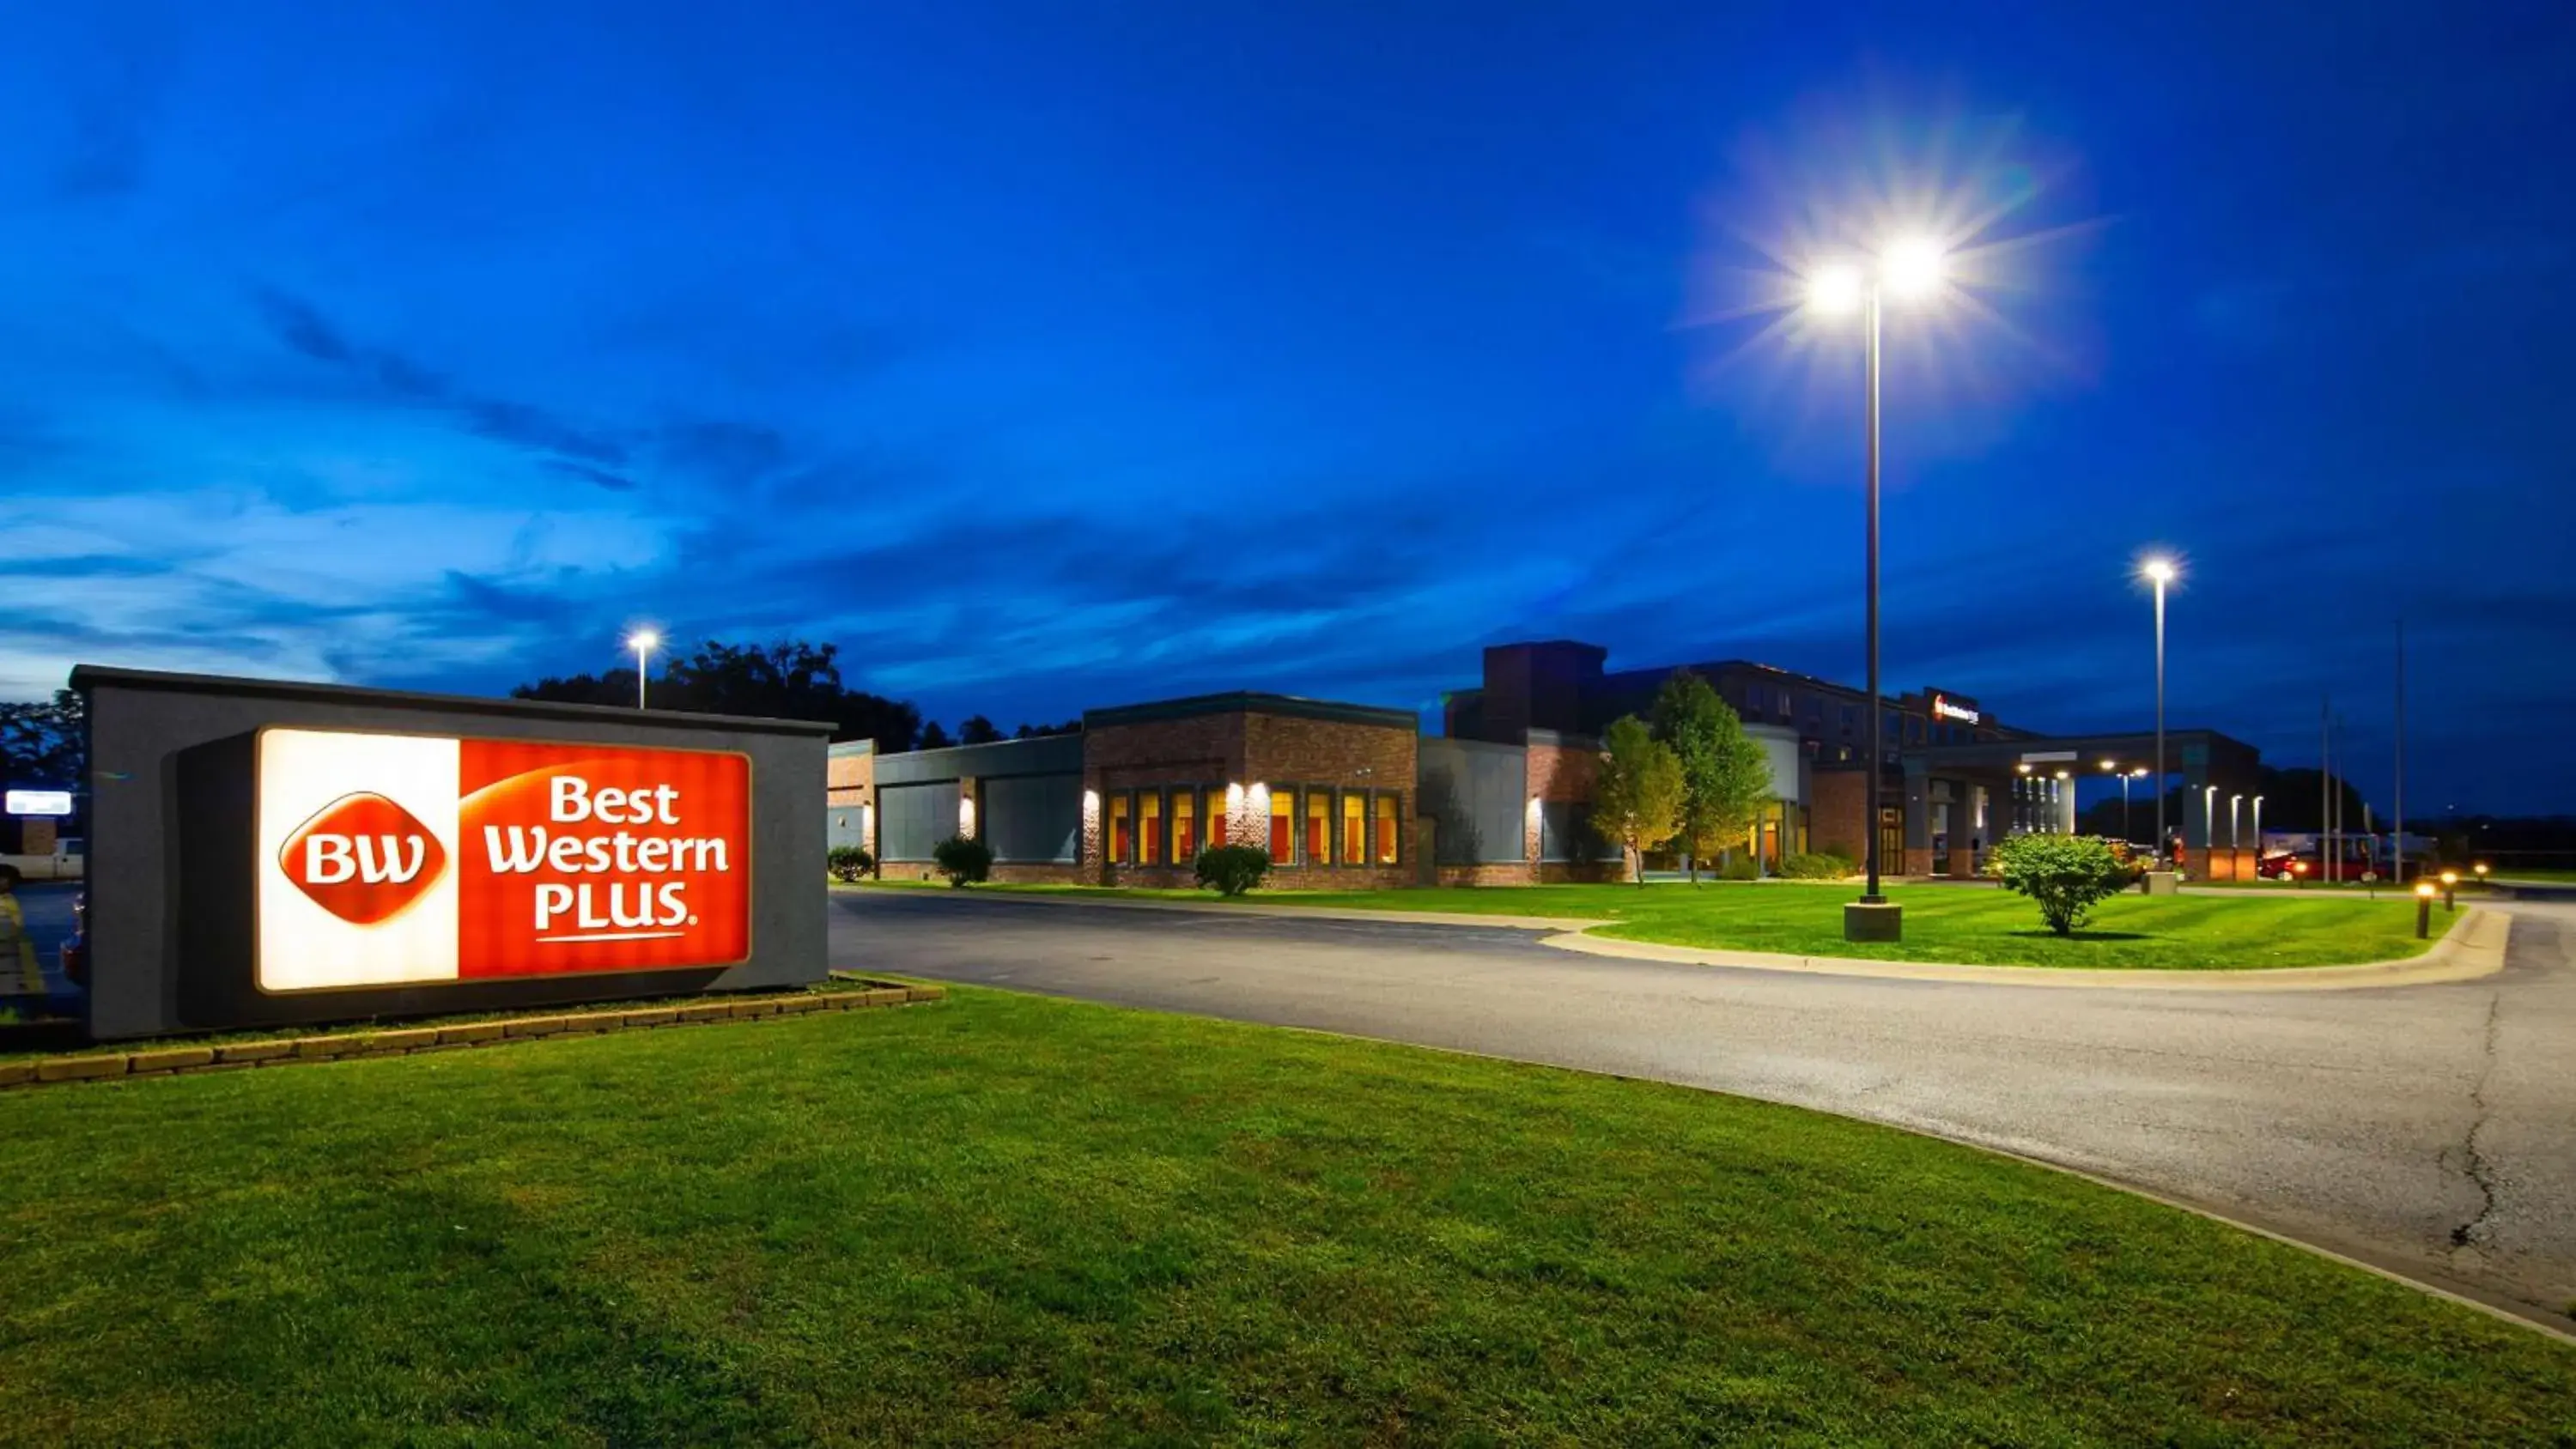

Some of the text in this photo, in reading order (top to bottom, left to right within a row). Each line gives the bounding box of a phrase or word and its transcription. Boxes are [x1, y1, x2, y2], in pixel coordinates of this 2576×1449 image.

[550, 775, 680, 824] Best
[305, 833, 425, 884] BW
[483, 825, 729, 873] Western
